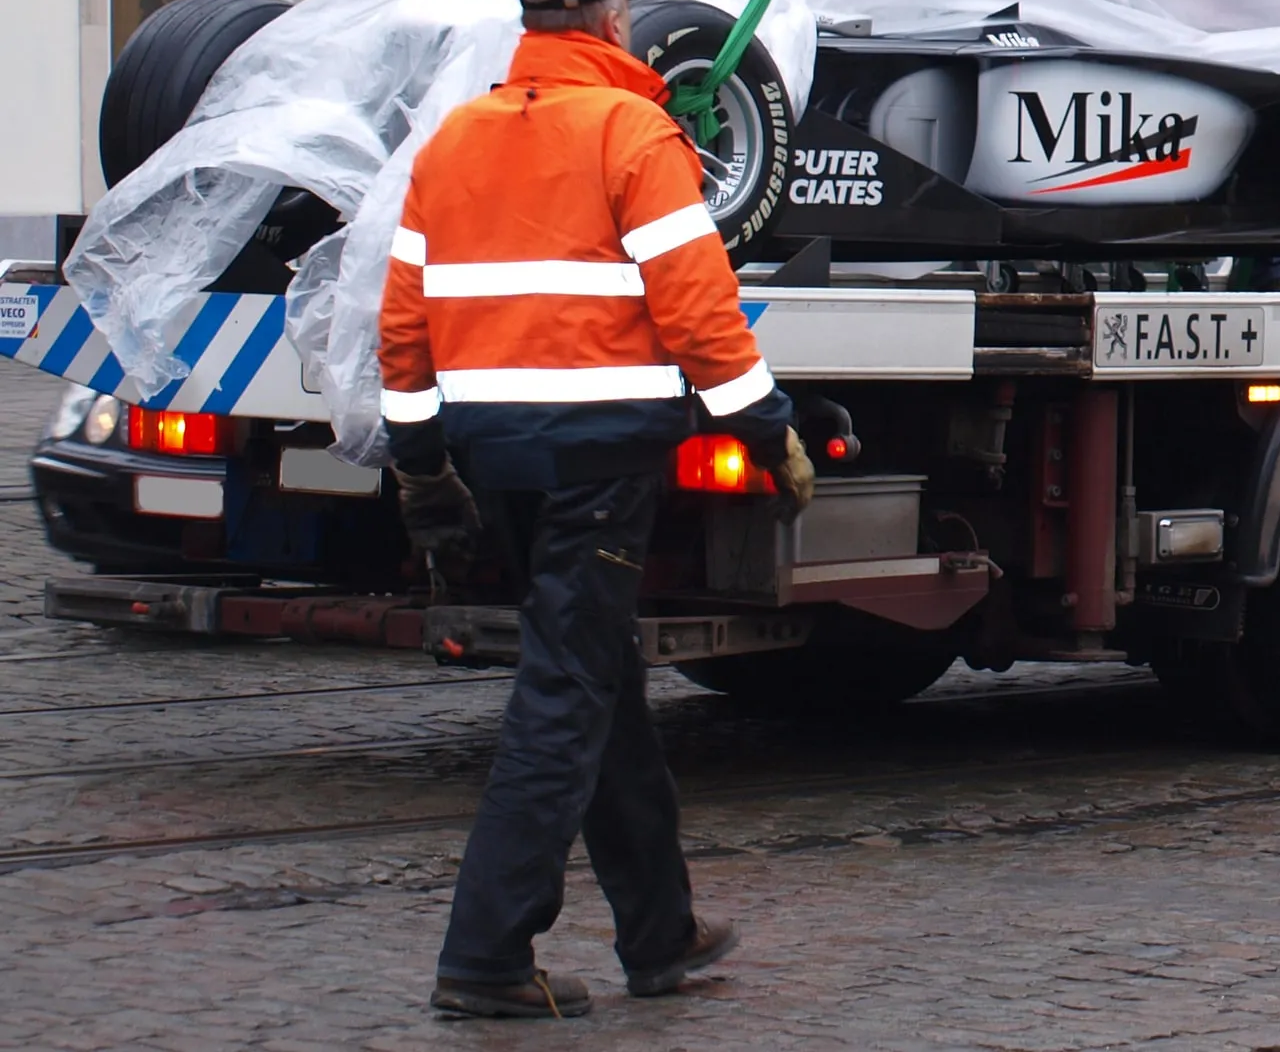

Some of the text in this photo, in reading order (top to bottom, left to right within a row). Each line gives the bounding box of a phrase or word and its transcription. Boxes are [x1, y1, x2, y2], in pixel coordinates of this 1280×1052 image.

[1006, 90, 1186, 163] Mika
[741, 80, 789, 243] BRIDGESTONE
[788, 178, 884, 206] CIATES
[1135, 313, 1230, 360] F.A.S.T.
